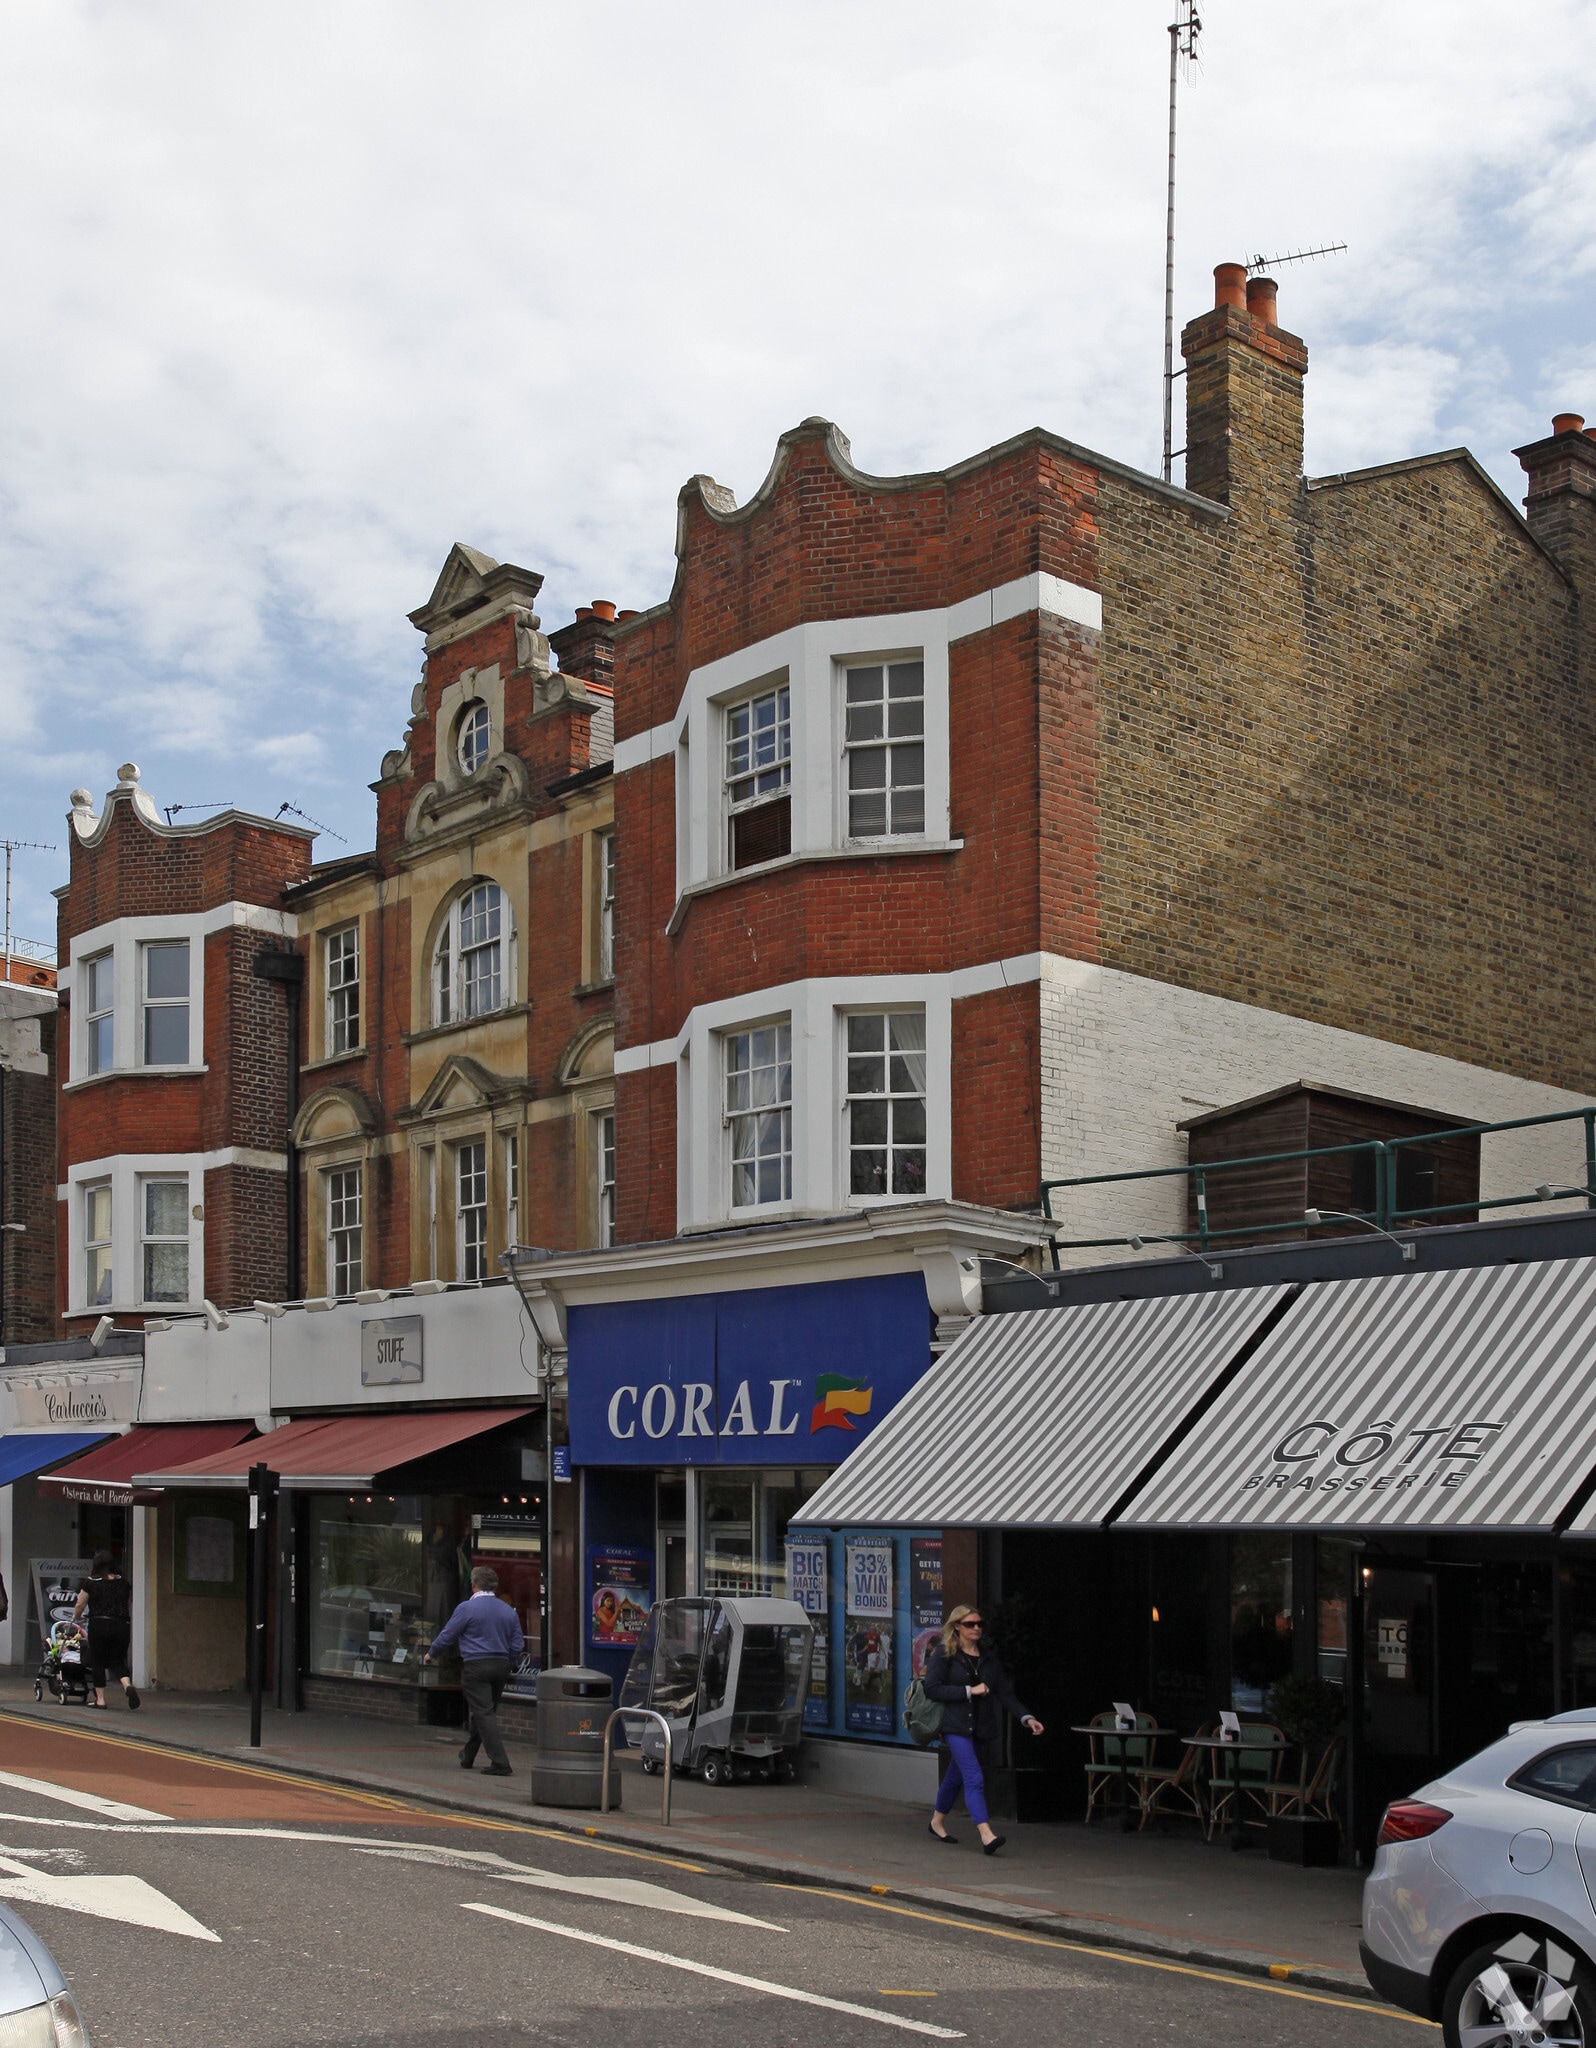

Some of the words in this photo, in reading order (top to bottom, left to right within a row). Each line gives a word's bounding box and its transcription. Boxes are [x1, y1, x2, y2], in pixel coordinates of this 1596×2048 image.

[377, 1337, 405, 1364] STUFF
[44, 1391, 107, 1423] Carluccio's
[608, 1380, 799, 1439] CORAL
[1272, 1419, 1508, 1467] CÔTE
[1241, 1471, 1469, 1492] BRASSERIE
[62, 1485, 91, 1501] Osteria
[93, 1488, 106, 1503] del
[108, 1489, 134, 1504] Portico
[793, 1551, 823, 1576] BIG
[854, 1553, 888, 1574] 33%
[919, 1560, 931, 1568] GET
[793, 1576, 823, 1589] MATCH
[854, 1574, 888, 1595] WIN
[793, 1589, 823, 1610] BET
[854, 1595, 888, 1608] BONUS
[920, 1617, 929, 1625] UP
